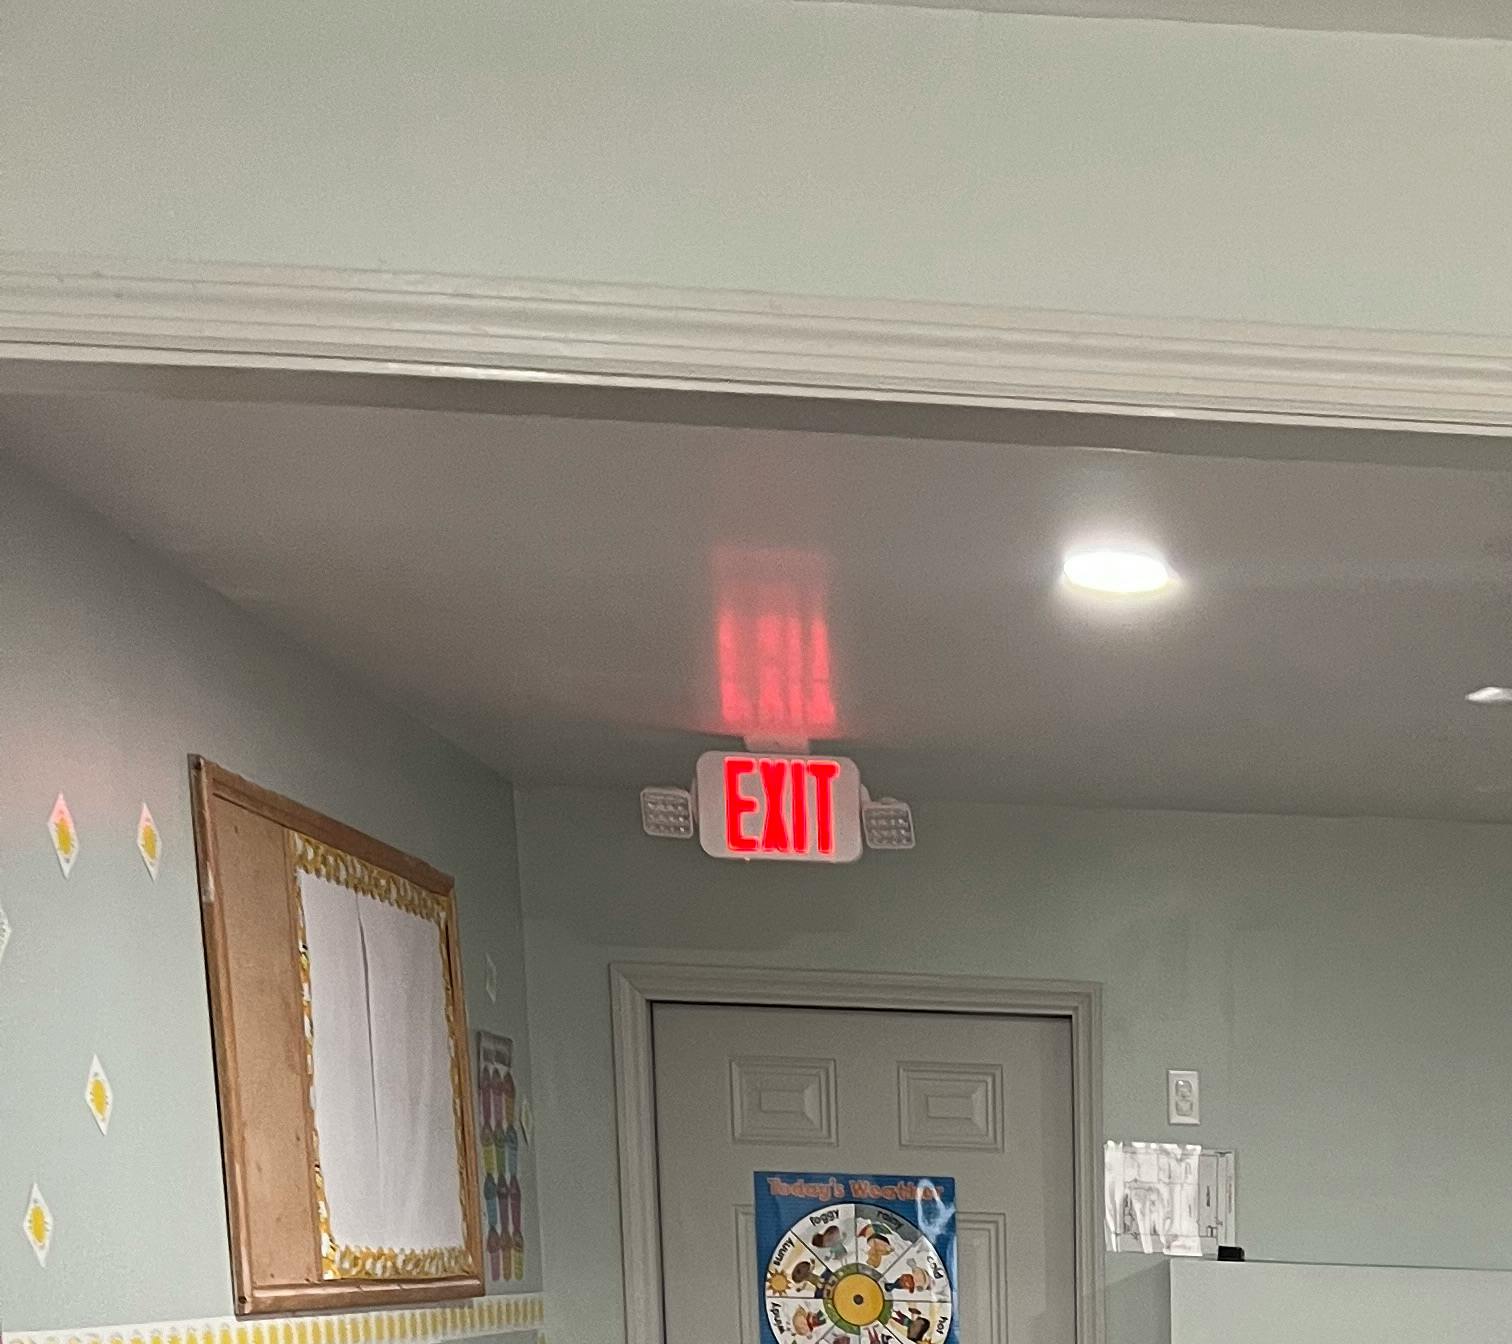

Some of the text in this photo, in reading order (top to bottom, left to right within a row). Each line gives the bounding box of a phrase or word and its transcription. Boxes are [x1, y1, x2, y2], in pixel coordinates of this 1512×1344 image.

[723, 756, 840, 855] EXIT
[767, 1177, 944, 1202] Today's Weather
[809, 1208, 840, 1227] foggy
[773, 1236, 796, 1267] sunny
[935, 1315, 949, 1335] hot
